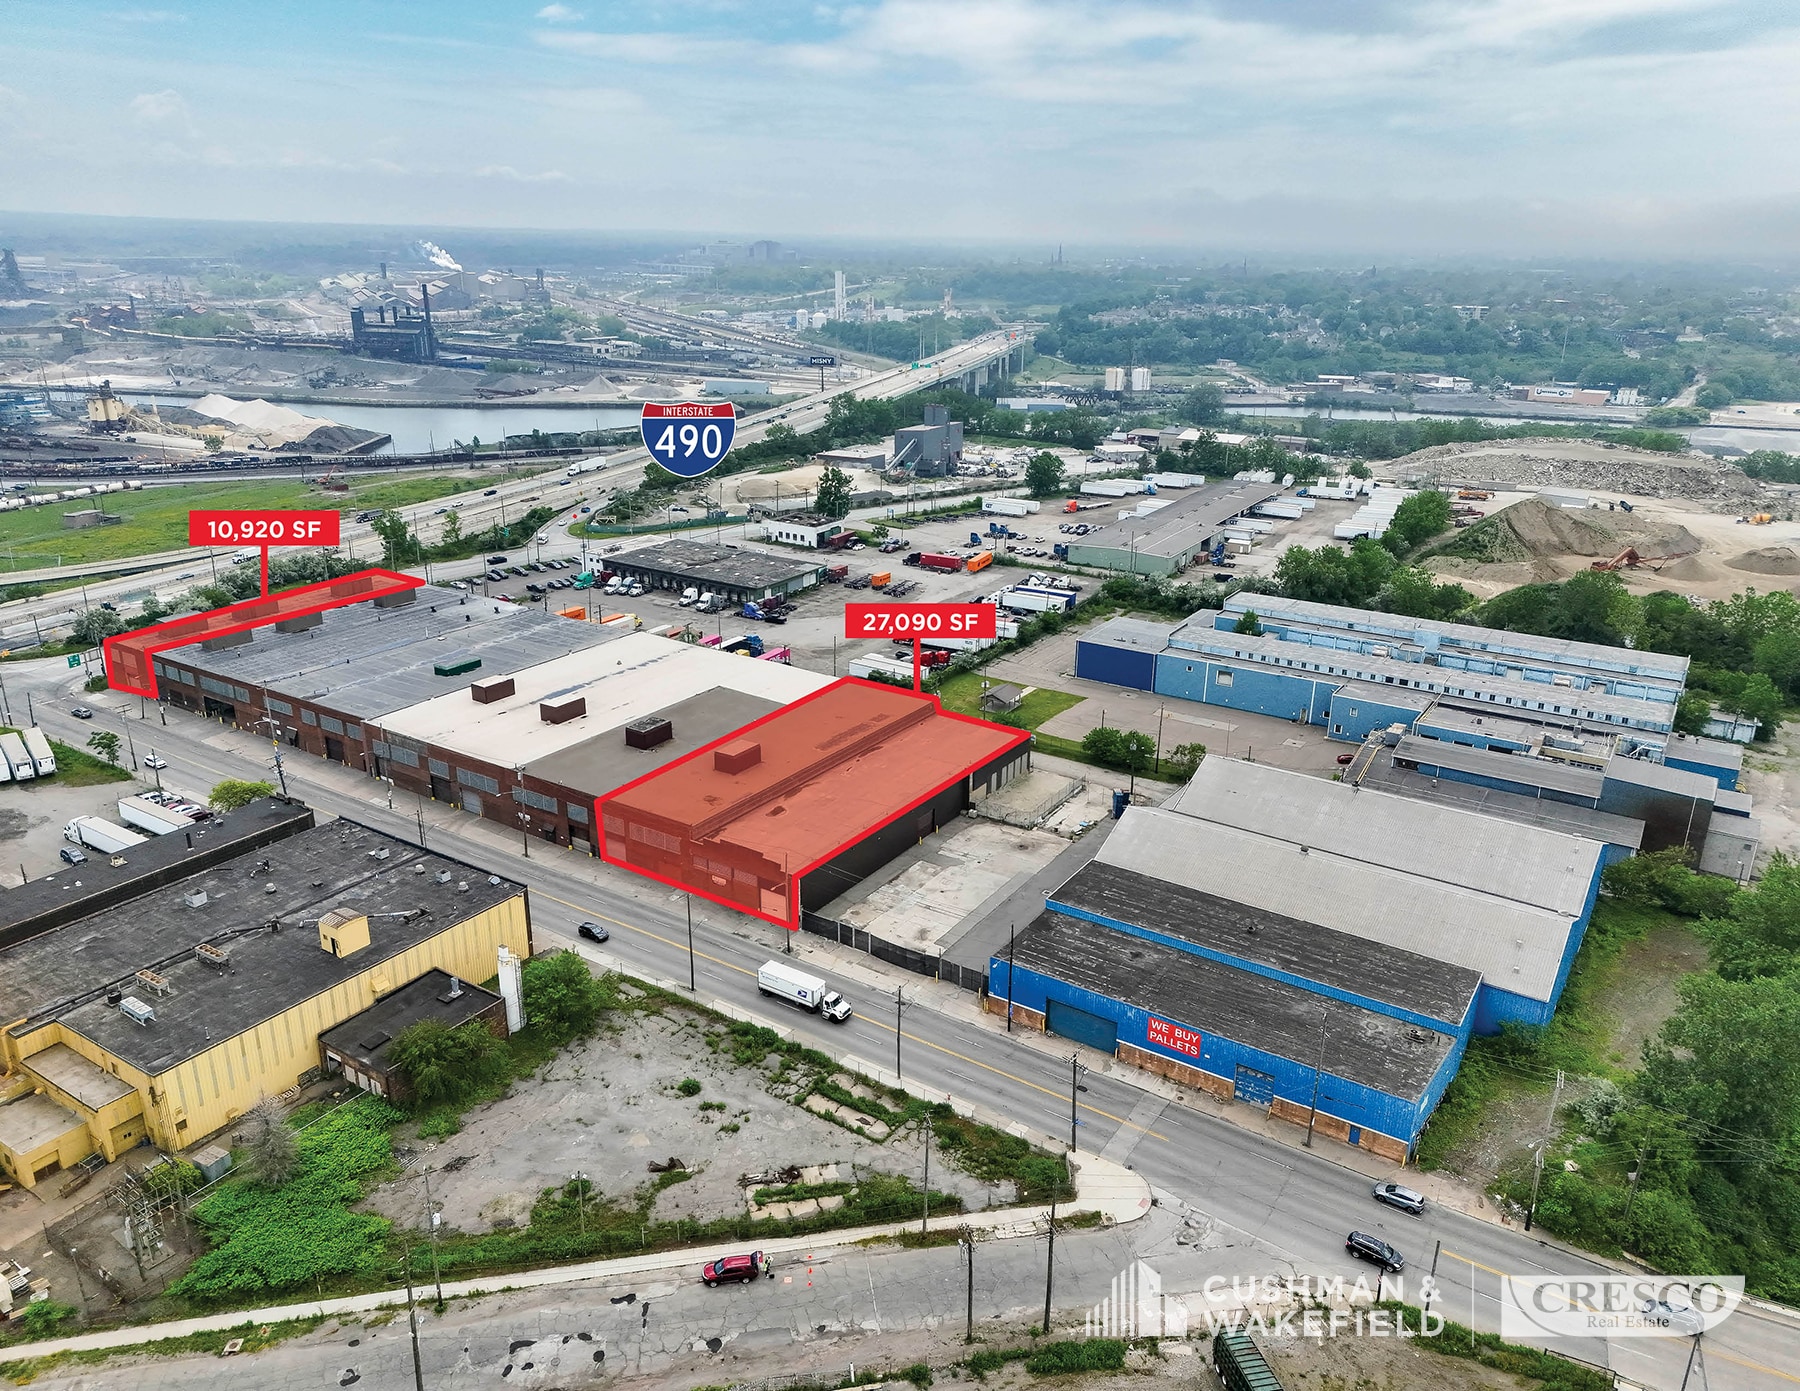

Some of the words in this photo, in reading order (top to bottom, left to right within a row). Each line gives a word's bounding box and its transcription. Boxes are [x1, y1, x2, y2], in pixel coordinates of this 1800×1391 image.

[1149, 1031, 1198, 1055] PALLETS
[1151, 1020, 1169, 1033] WE
[1175, 1028, 1199, 1043] BUY
